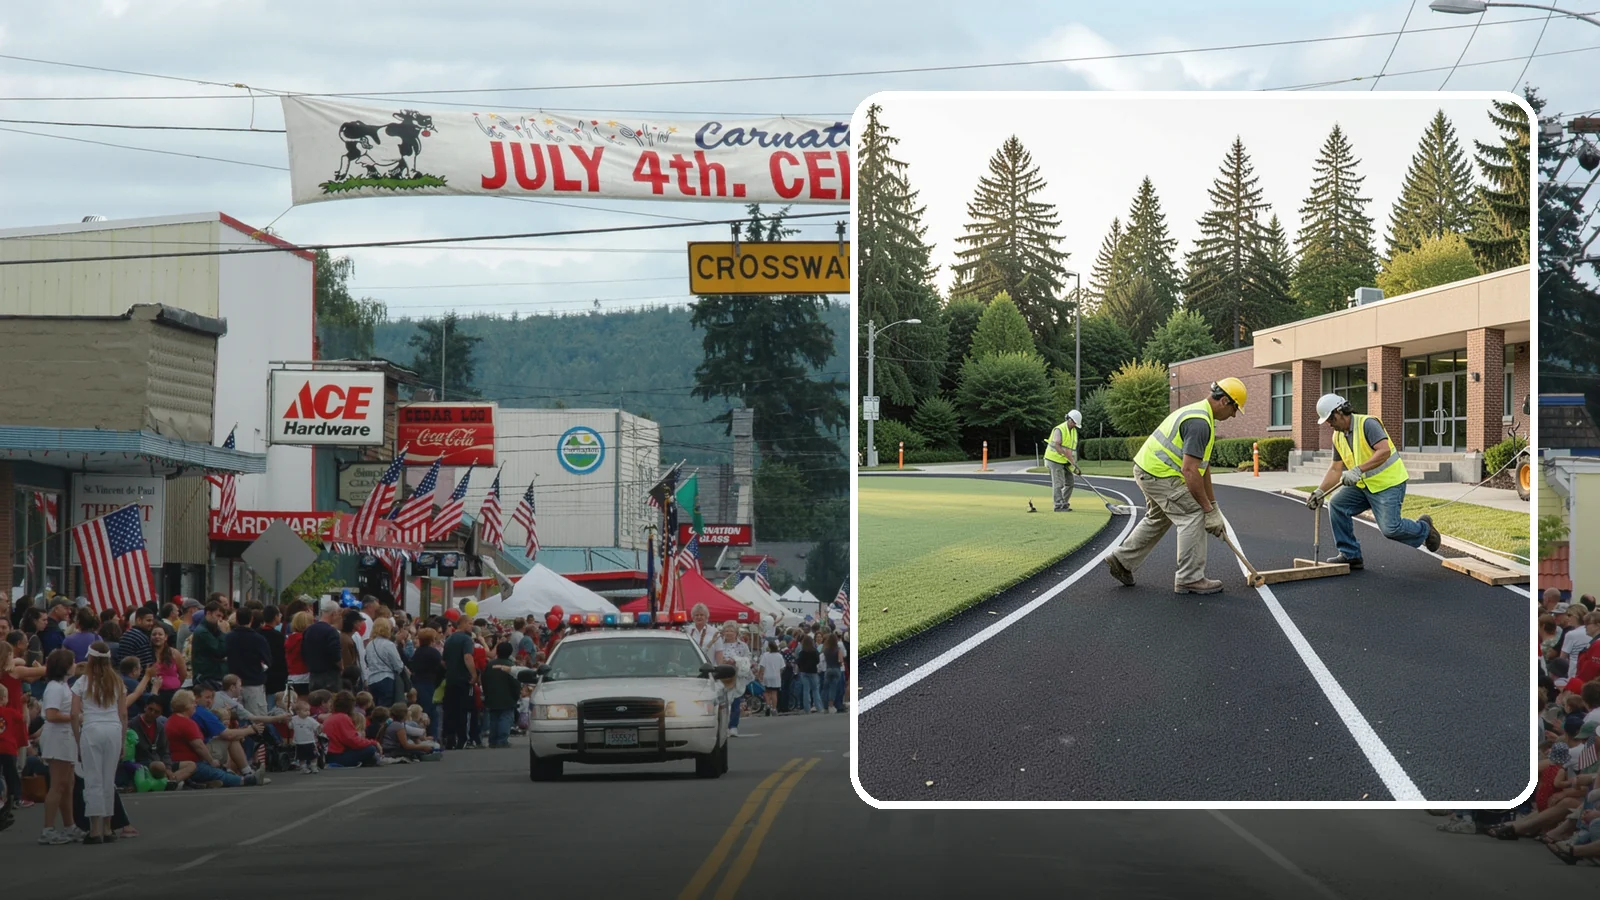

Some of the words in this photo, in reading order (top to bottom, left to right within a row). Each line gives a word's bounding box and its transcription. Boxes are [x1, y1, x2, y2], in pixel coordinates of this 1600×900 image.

[695, 121, 850, 150] Carnat
[481, 141, 605, 193] JULY
[632, 150, 746, 197] 4th.
[697, 254, 850, 280] CROSSWA
[283, 380, 373, 420] ACE
[406, 409, 452, 422] CEDAR
[283, 421, 371, 437] Hardware
[95, 485, 125, 495] Vincent
[126, 486, 136, 494] de
[137, 486, 155, 495] Paul
[688, 526, 741, 535] CRNATION
[699, 535, 730, 543] GLASS
